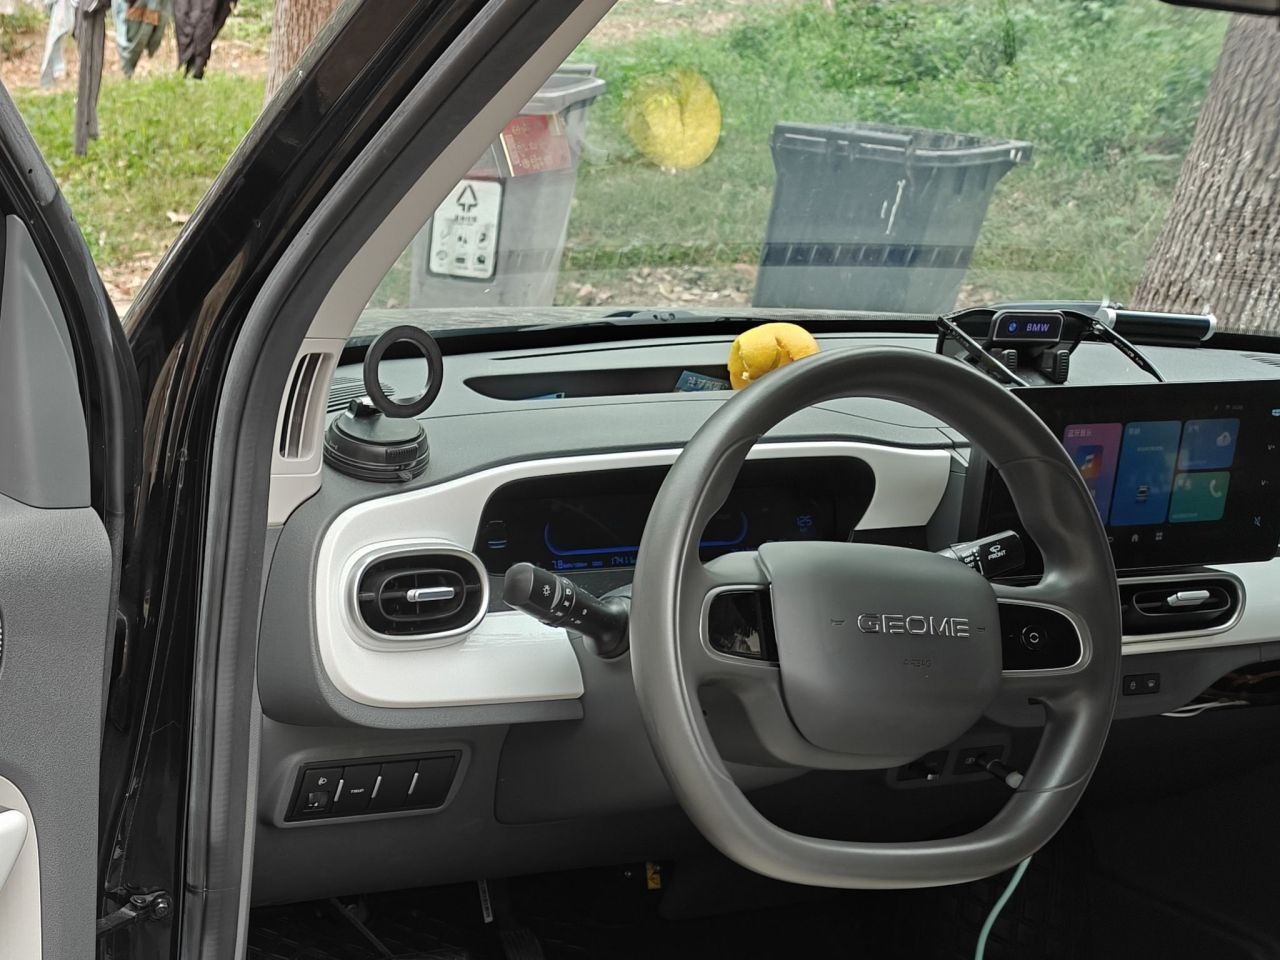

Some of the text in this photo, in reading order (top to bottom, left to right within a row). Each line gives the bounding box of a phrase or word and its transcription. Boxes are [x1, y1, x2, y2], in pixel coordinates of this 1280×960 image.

[1026, 323, 1050, 332] BMW
[988, 550, 1007, 560] FRONT
[857, 612, 970, 638] GEOME
